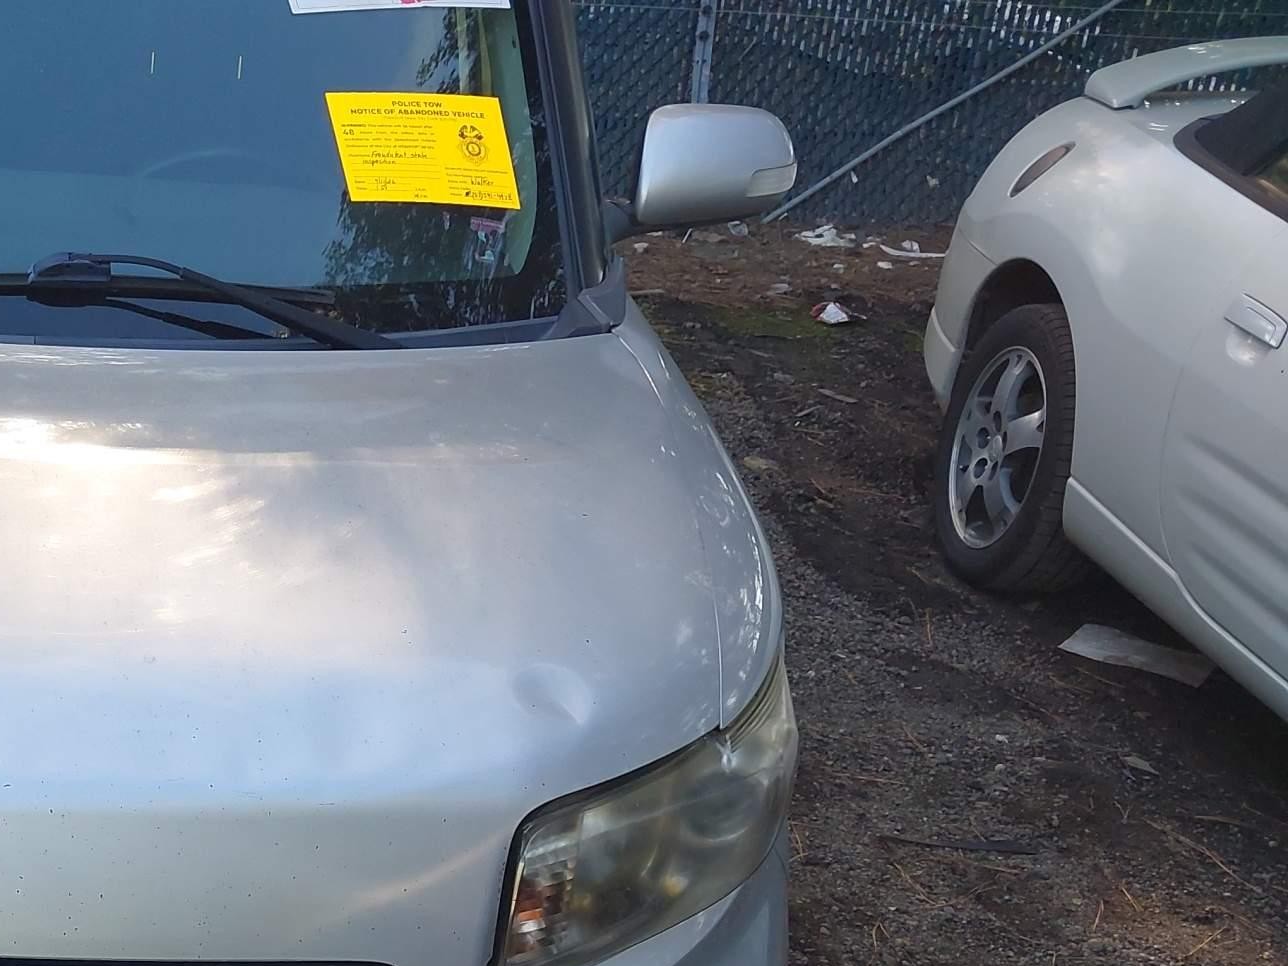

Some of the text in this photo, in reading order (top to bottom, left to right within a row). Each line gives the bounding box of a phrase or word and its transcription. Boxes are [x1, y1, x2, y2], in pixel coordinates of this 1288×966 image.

[391, 100, 442, 109] POLICE TOW
[398, 109, 450, 117] ABANDONED
[452, 111, 485, 119] VEHICLE
